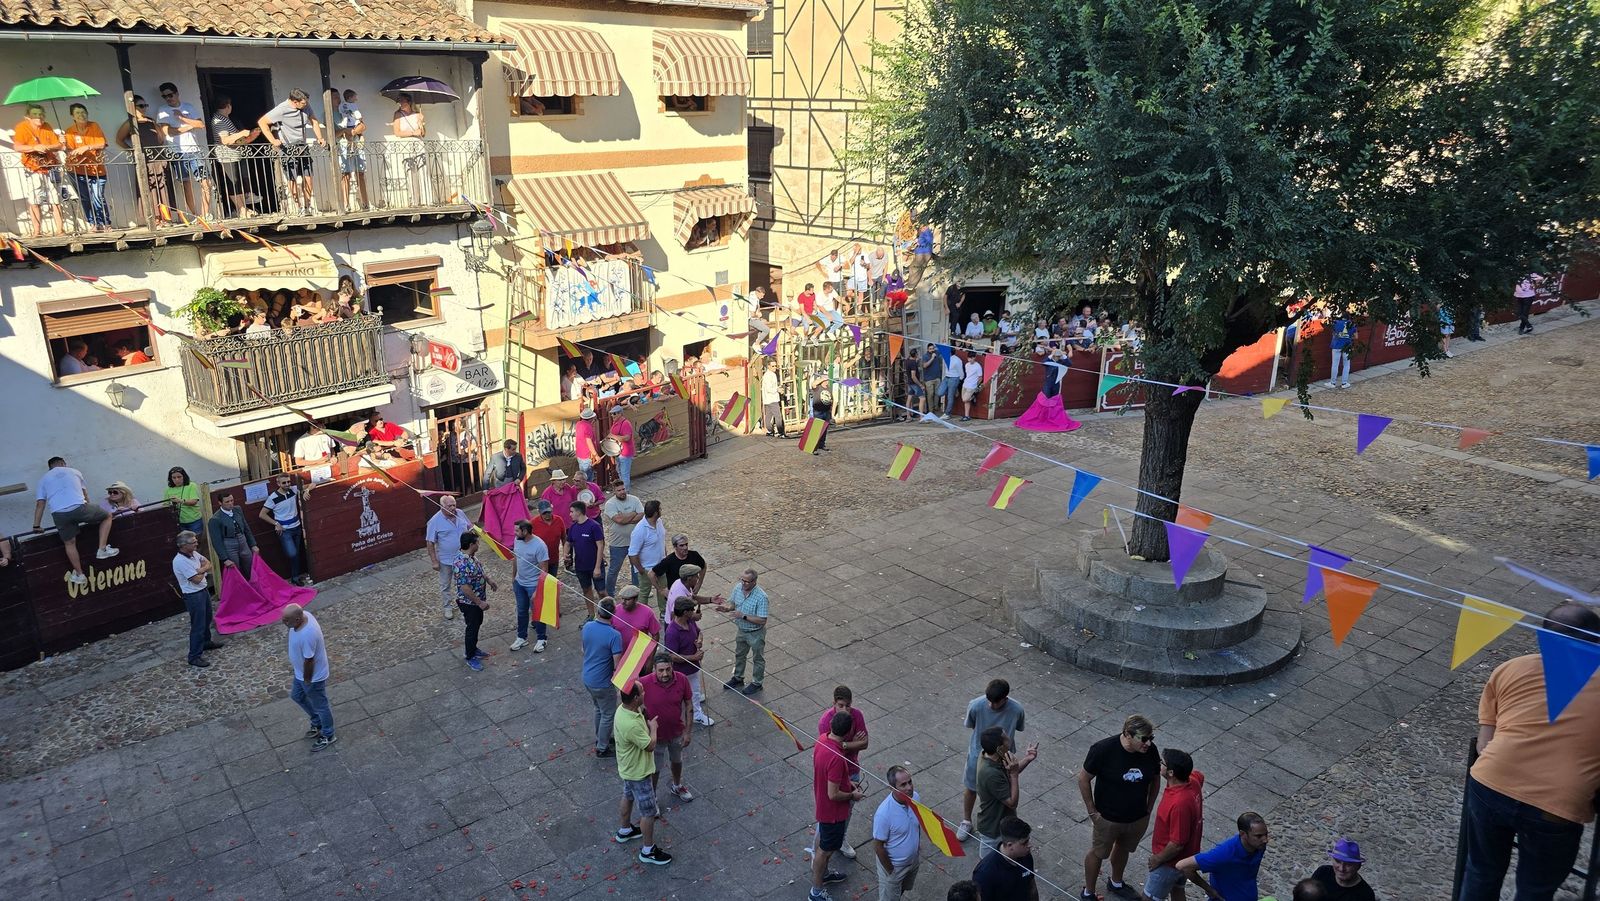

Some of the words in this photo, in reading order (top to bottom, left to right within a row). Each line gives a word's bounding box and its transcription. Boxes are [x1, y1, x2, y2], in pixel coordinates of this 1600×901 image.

[465, 366, 489, 380] BAR
[351, 540, 366, 549] Peña
[366, 536, 376, 544] del
[376, 531, 394, 540] Cristo
[63, 559, 147, 599] Veterana
